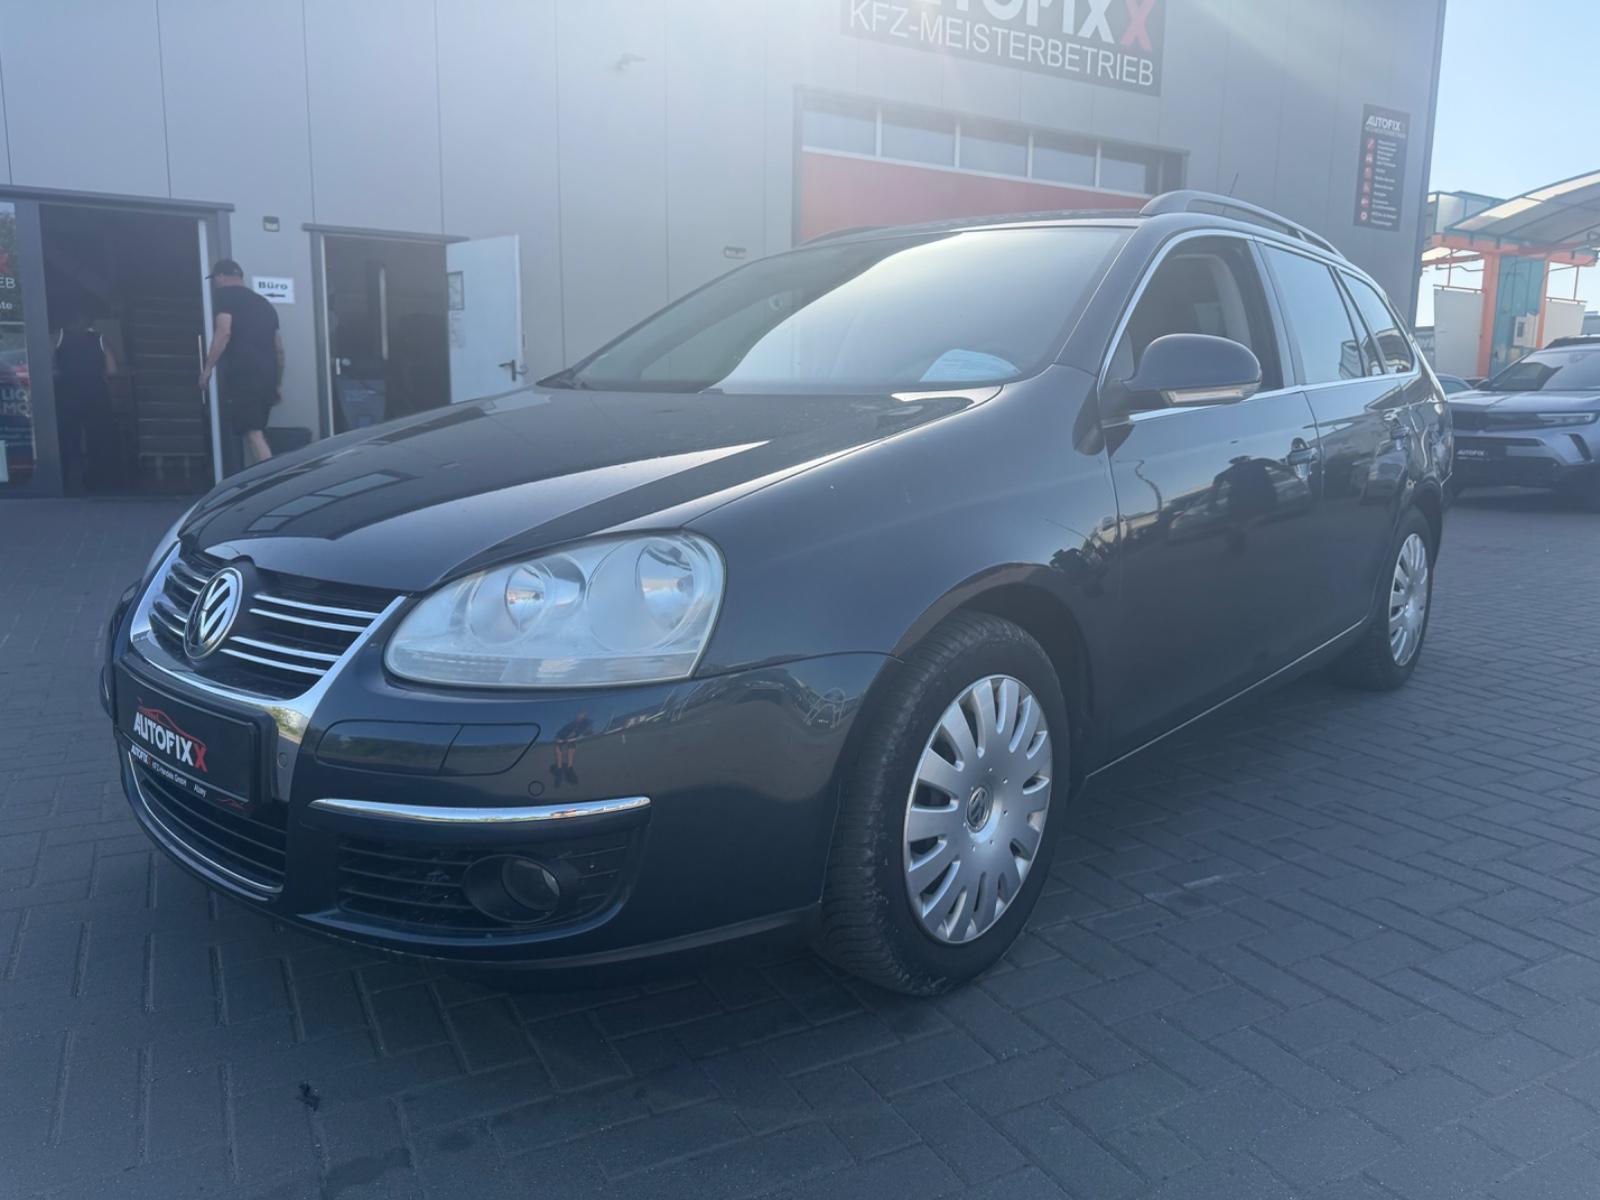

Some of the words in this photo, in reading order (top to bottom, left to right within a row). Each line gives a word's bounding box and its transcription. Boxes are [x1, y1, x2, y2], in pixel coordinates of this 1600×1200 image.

[849, 0, 1153, 86] KFZ-MEISTERBETRIEB
[258, 281, 288, 290] Büro
[133, 711, 208, 772] AUTOFIXX
